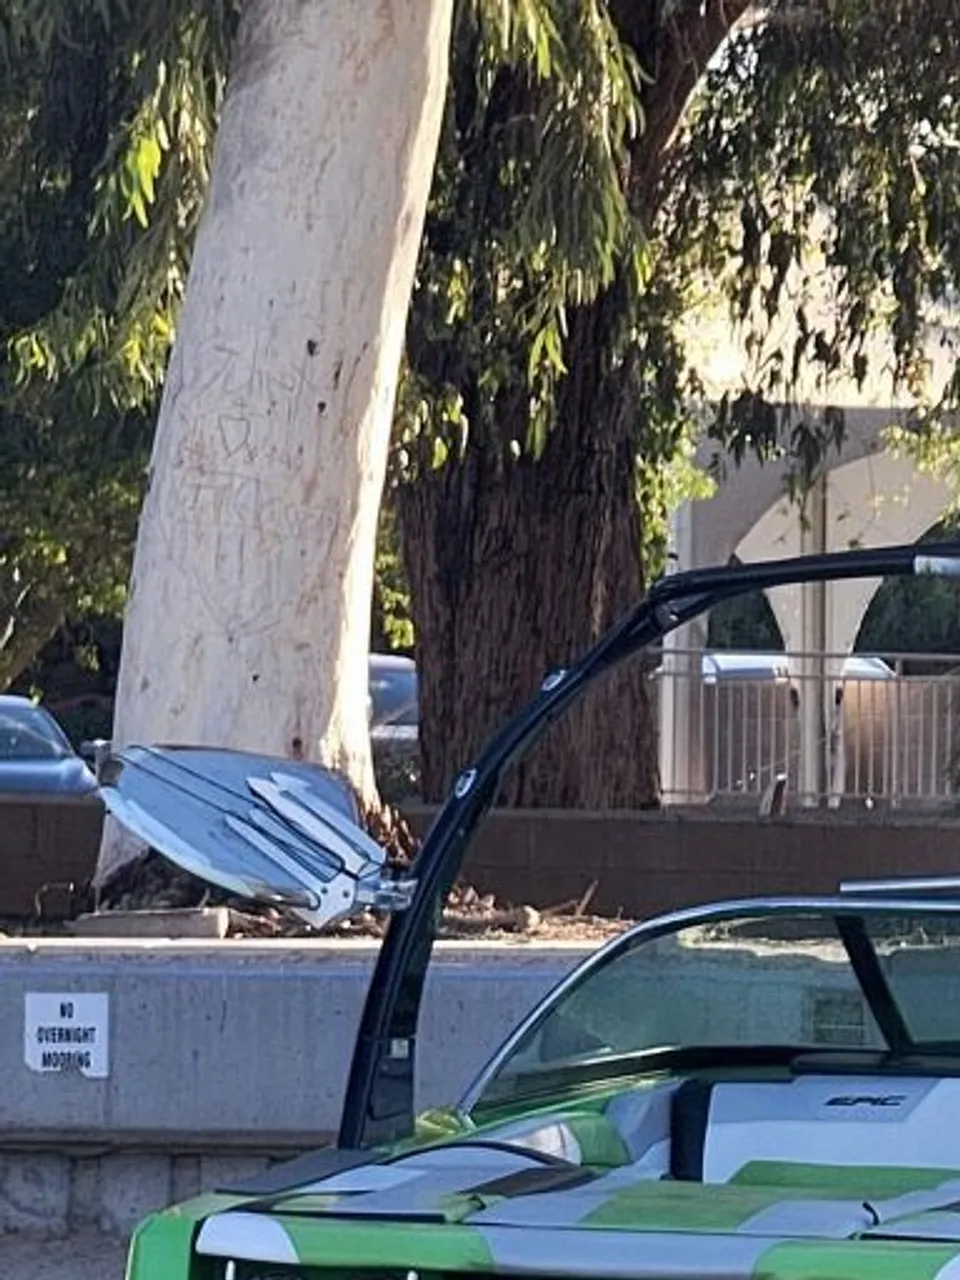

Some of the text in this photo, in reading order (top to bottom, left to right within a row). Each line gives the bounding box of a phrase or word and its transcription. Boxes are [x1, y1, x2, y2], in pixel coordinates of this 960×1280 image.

[59, 1001, 74, 1019] NO
[37, 1027, 97, 1044] OVERNIGHT
[823, 1094, 907, 1107] EPIC
